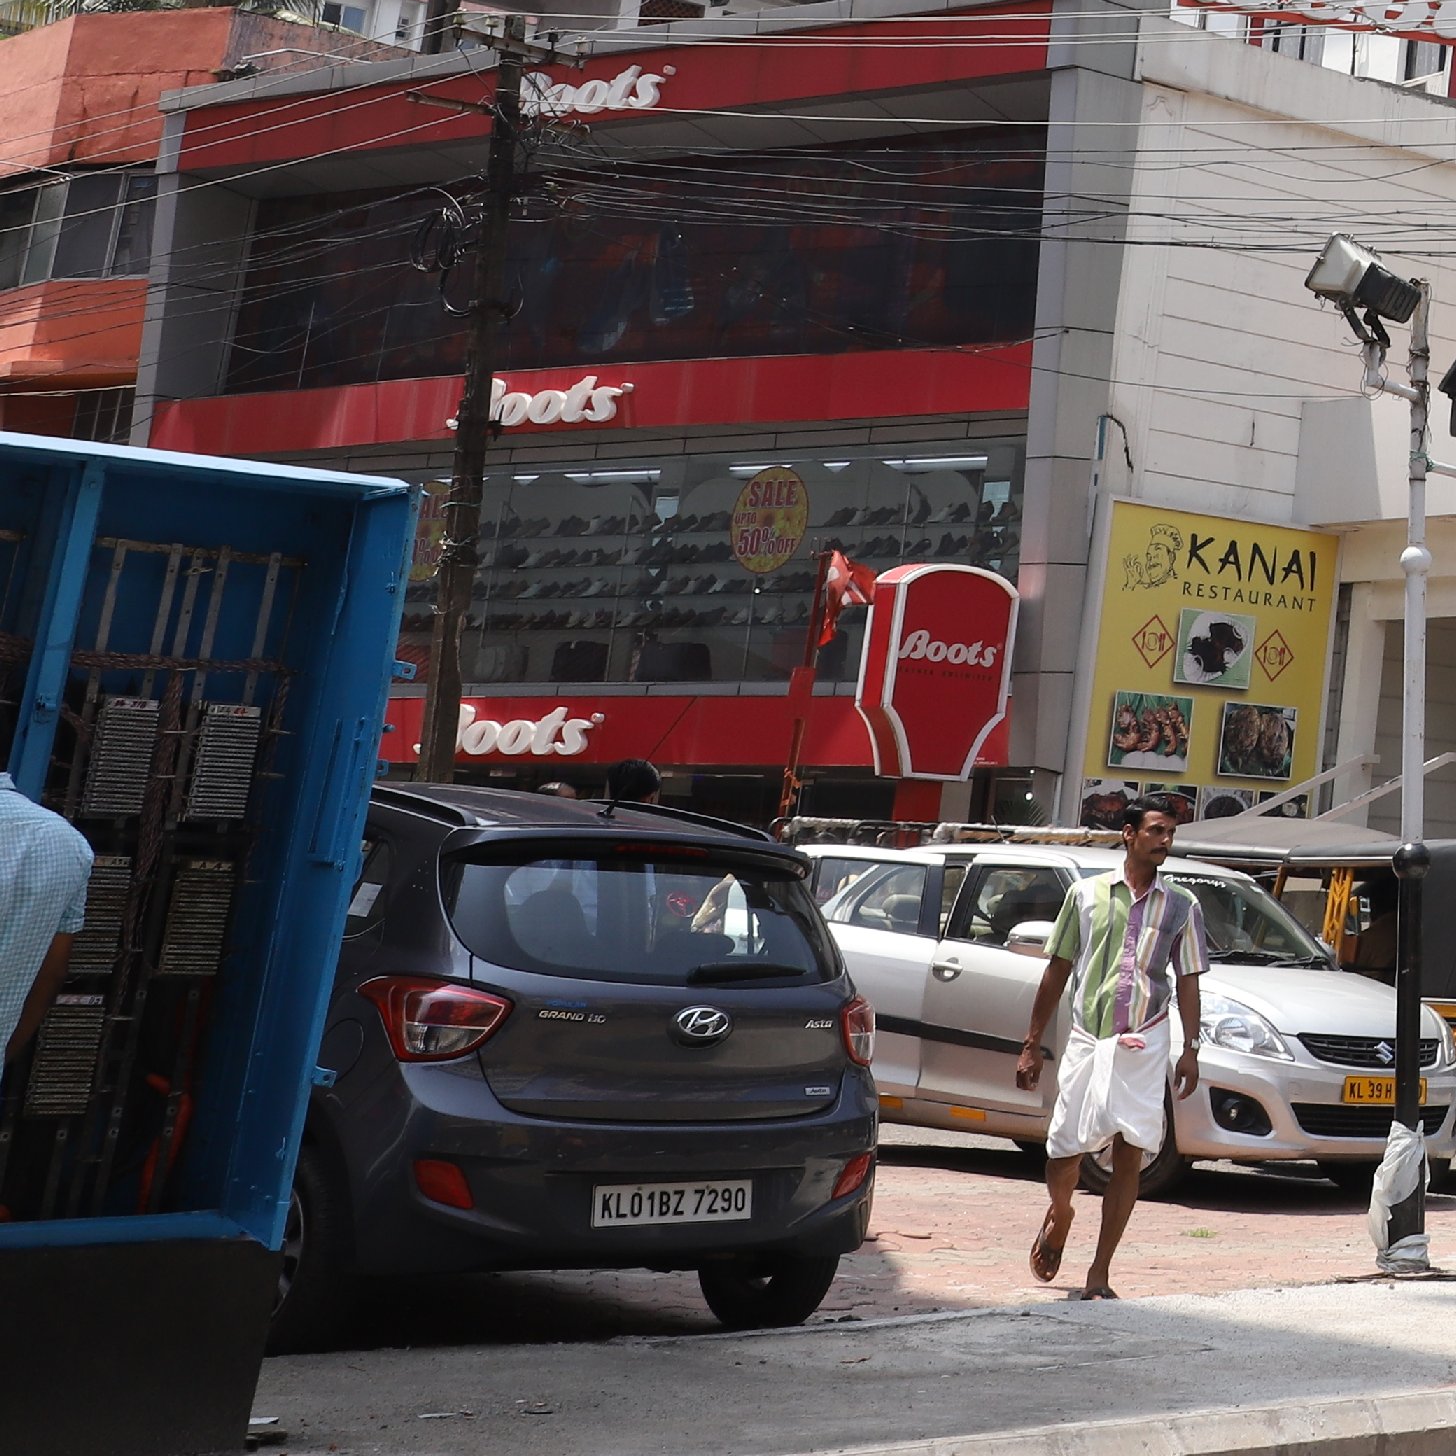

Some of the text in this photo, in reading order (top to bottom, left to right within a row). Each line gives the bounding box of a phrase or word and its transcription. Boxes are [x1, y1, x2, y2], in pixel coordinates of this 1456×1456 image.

[749, 480, 798, 508] SALE
[735, 512, 757, 524] UPTO
[737, 527, 796, 556] 50% OFF
[1186, 533, 1317, 591] KANAI
[1183, 581, 1316, 612] RESTAURANT
[898, 630, 999, 668] Boots
[539, 1010, 584, 1022] GRAND
[1349, 1082, 1363, 1099] KL
[1368, 1082, 1382, 1098] 39
[601, 1187, 745, 1219] KL01BZ 7290
